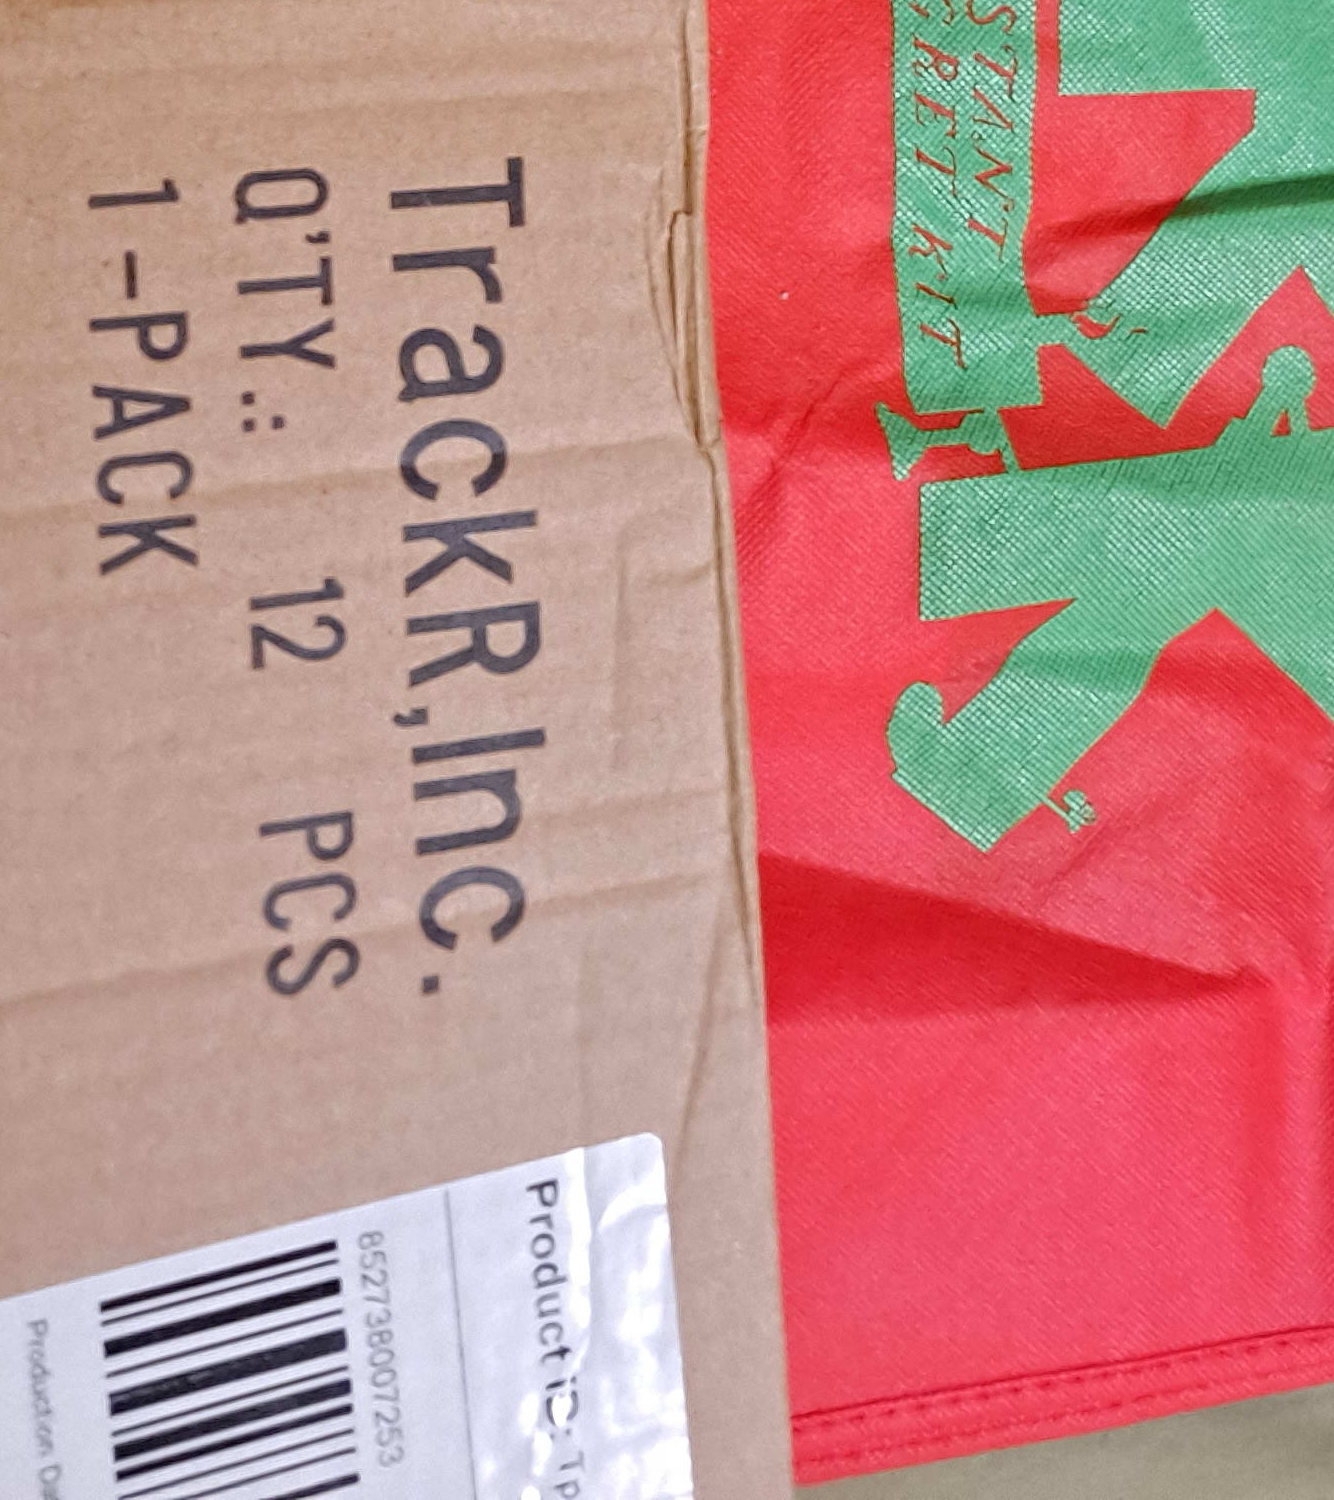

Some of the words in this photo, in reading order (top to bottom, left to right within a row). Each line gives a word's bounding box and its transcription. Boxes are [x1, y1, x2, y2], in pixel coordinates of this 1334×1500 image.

[906, 224, 967, 372] KIT
[246, 575, 348, 671] 12
[388, 155, 547, 996] TrackR,Inc.
[256, 810, 361, 997] PCS
[356, 1230, 406, 1470] 852738007253
[523, 1179, 575, 1364] Product
[25, 1318, 56, 1457] Production
